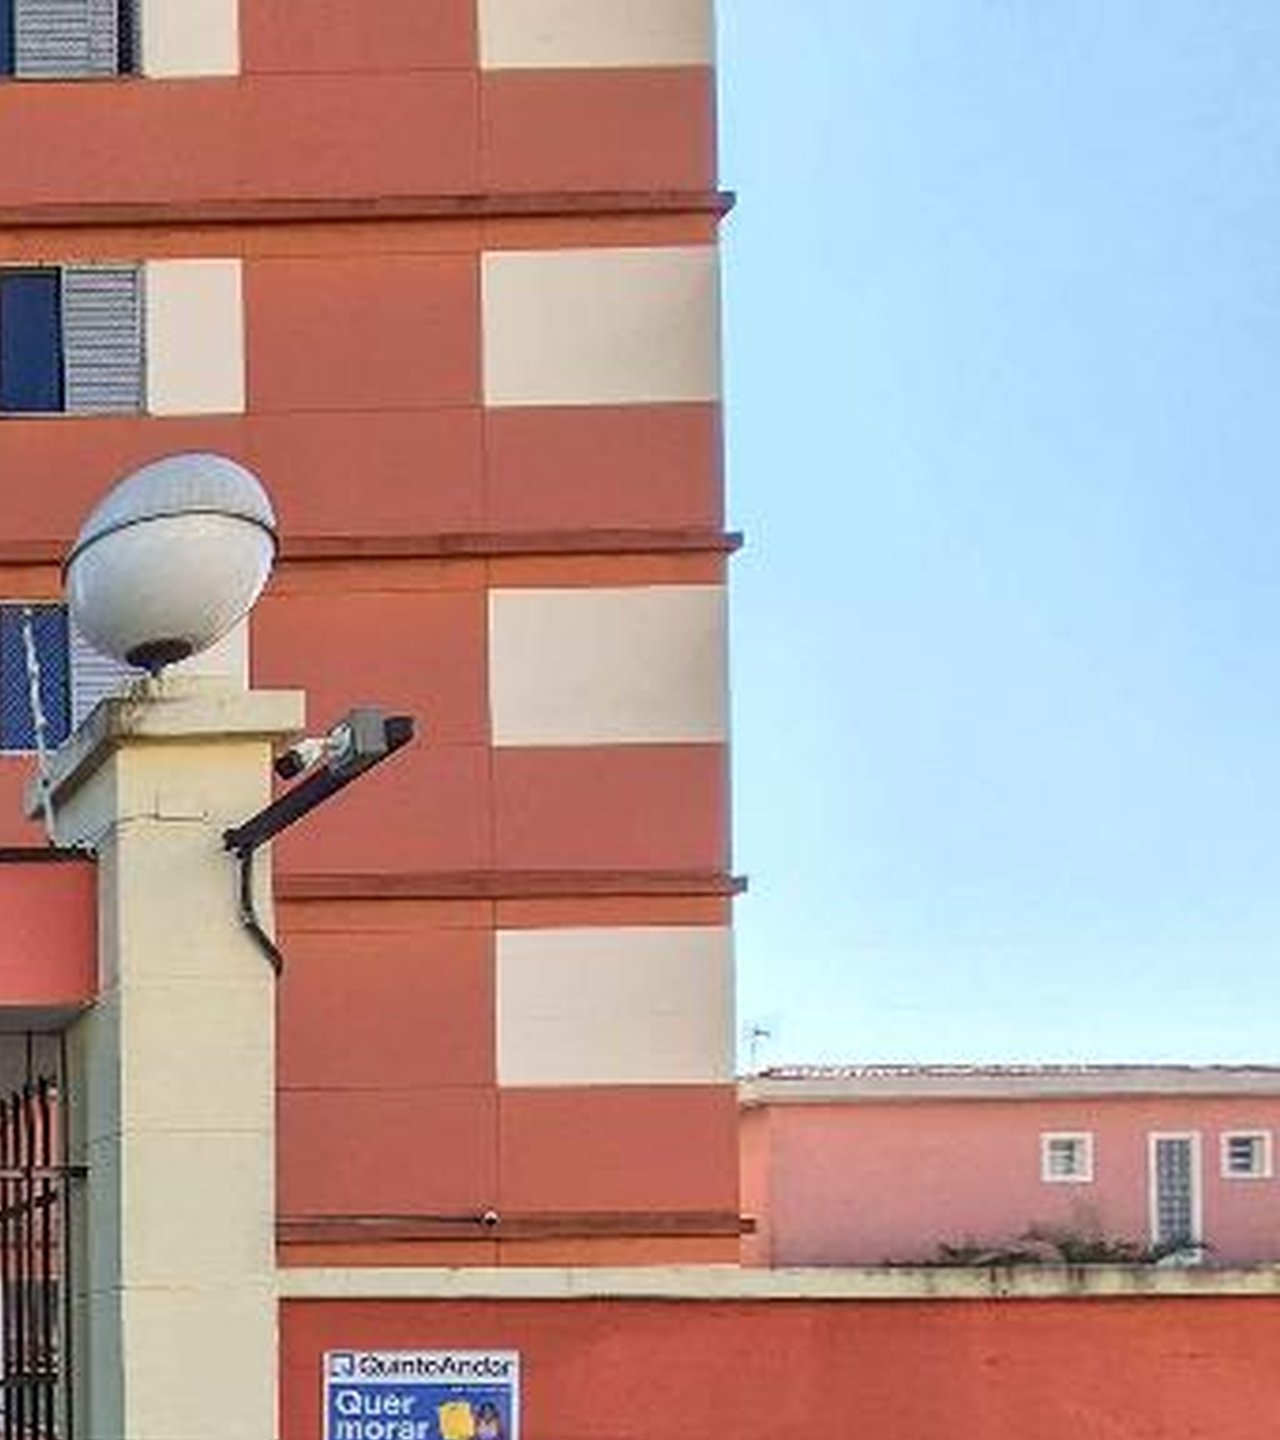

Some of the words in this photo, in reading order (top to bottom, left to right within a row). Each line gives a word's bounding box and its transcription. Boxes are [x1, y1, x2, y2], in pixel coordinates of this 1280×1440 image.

[359, 1356, 512, 1377] QuintoAndar
[335, 1389, 416, 1415] Quer
[334, 1420, 430, 1440] morar
